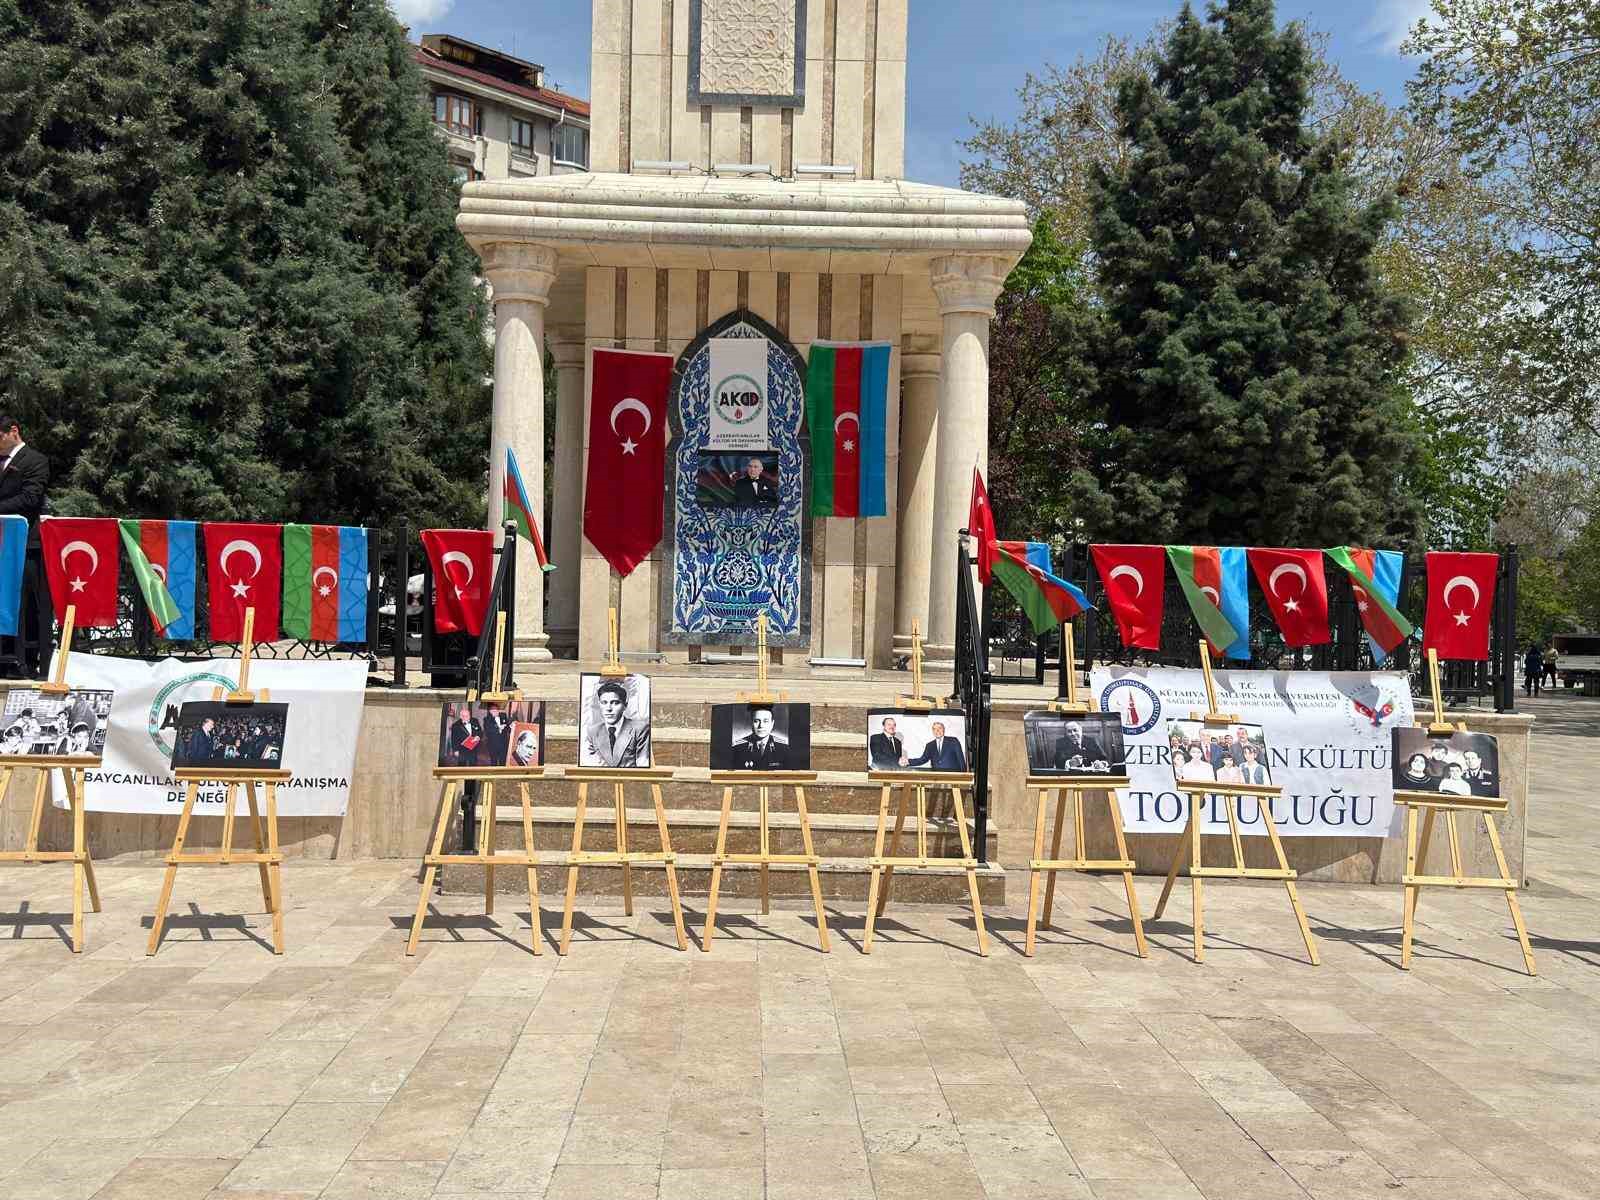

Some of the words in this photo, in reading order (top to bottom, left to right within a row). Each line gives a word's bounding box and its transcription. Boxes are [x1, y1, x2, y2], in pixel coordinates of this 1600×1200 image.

[1159, 689, 1204, 698] KÜTAHYA
[1215, 691, 1272, 699] MLUPINAR
[1300, 744, 1393, 770] KÜLTÜ
[75, 772, 182, 787] BAYCANLILAR
[272, 777, 348, 790] AYANIŞMA
[167, 789, 228, 804] DENEĞİ
